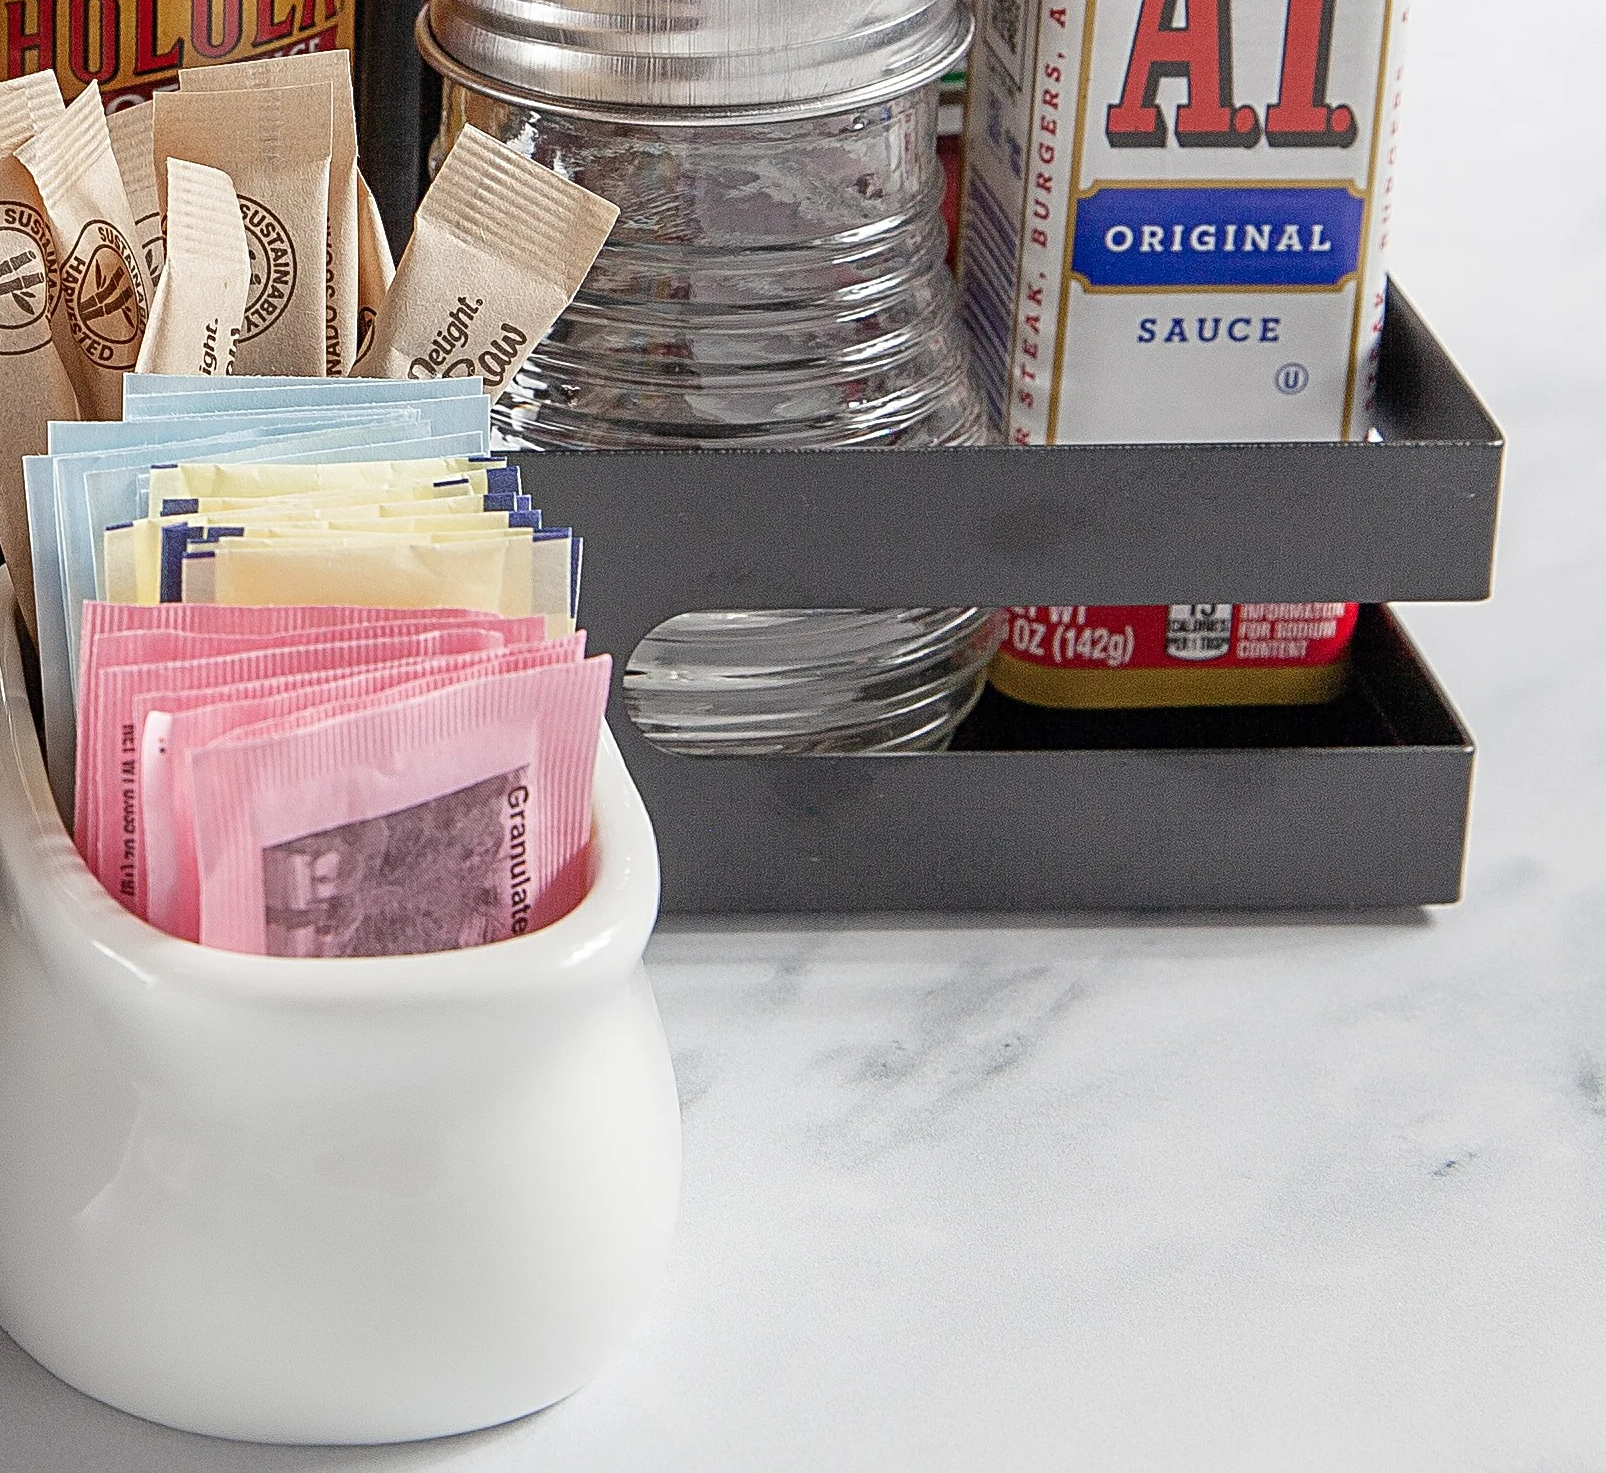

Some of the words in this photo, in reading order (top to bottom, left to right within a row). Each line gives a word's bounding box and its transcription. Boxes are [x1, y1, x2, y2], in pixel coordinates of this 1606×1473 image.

[1104, 224, 1332, 253] ORIGINAL
[240, 203, 291, 334] SUSTAINABLY
[1137, 317, 1282, 344] SAUCE
[1012, 617, 1047, 656] OZ
[1052, 625, 1135, 667] (142g)
[507, 784, 532, 935] Granulate
